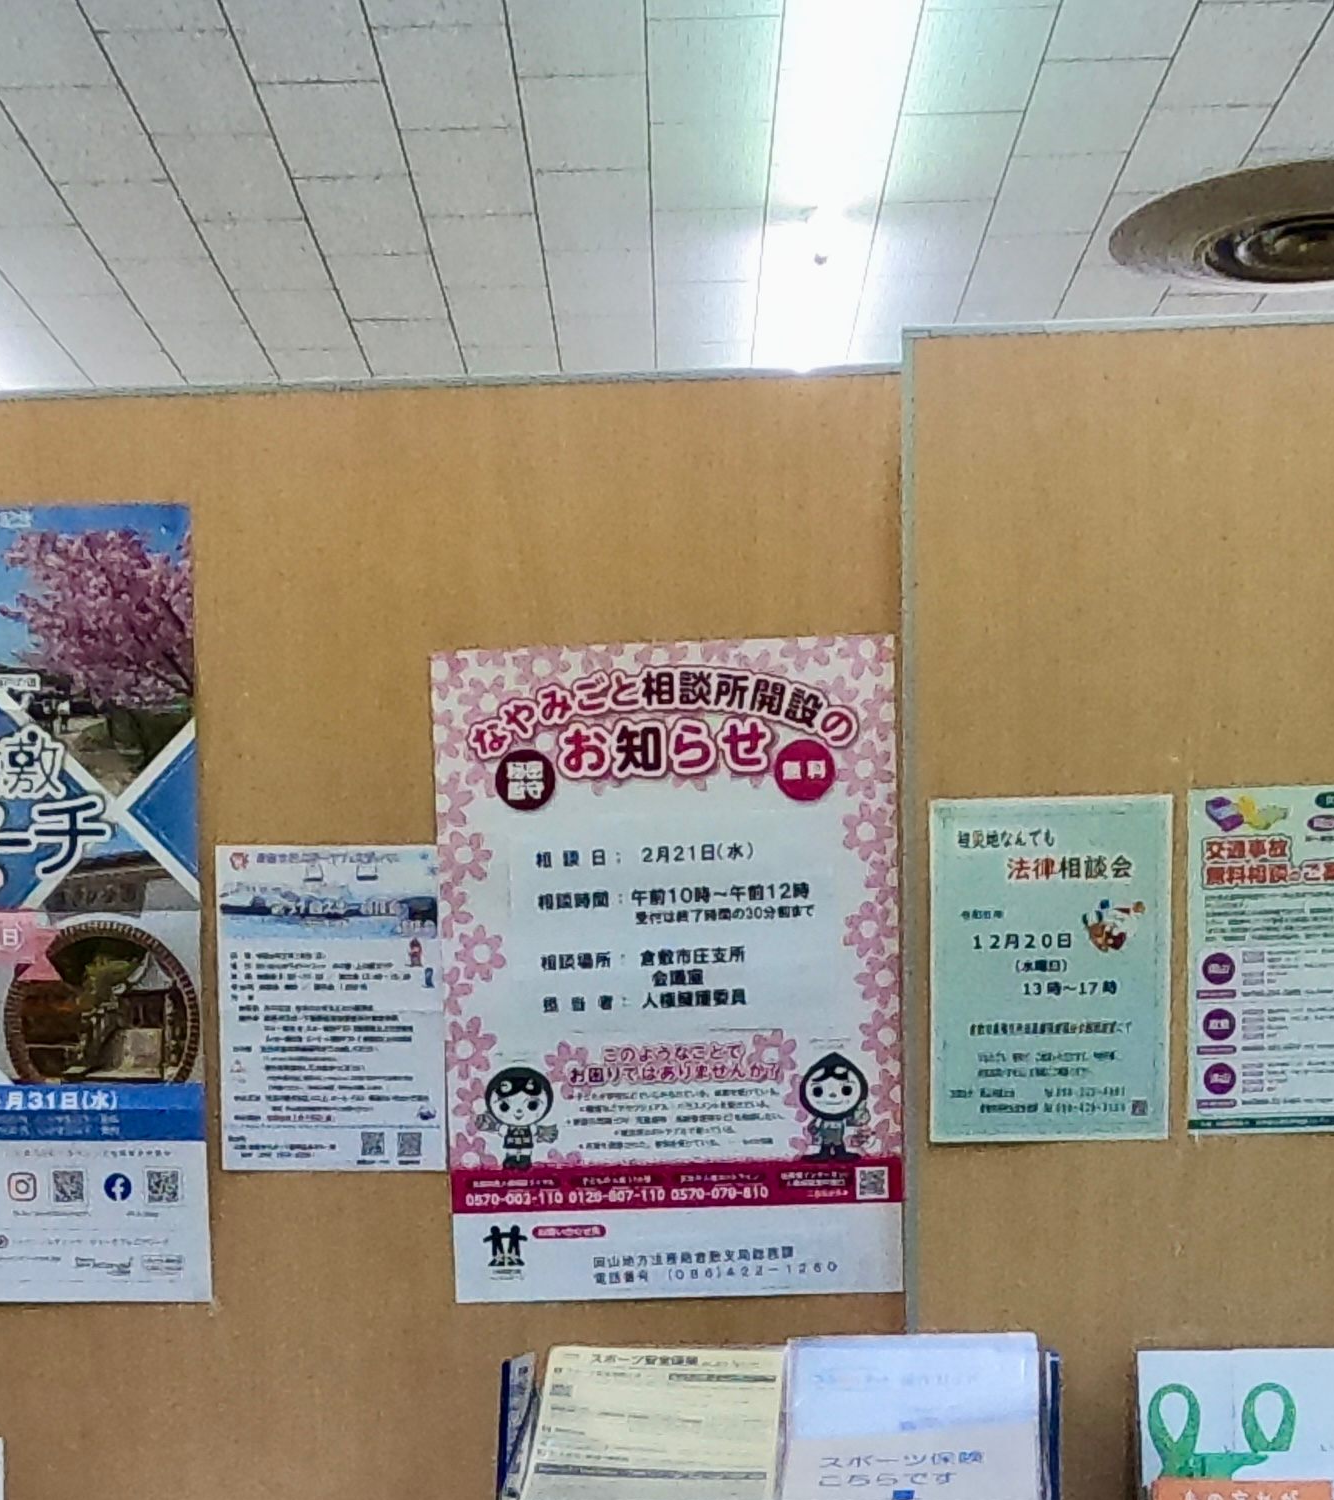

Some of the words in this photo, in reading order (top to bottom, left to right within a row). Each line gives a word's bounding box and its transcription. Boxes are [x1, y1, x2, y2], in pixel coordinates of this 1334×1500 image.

[473, 670, 854, 754] なやみごと相談所開設の
[561, 722, 769, 774] お知らせ
[642, 843, 754, 863] 2月21日(水)
[1006, 855, 1133, 880] 法律相談会
[973, 933, 1072, 950] 12月20日
[640, 946, 746, 967] 倉敷市庄支所
[1015, 958, 1068, 973] (水曜日)
[819, 1451, 985, 1470] スポーツ保険
[819, 1471, 958, 1487] こちらです
